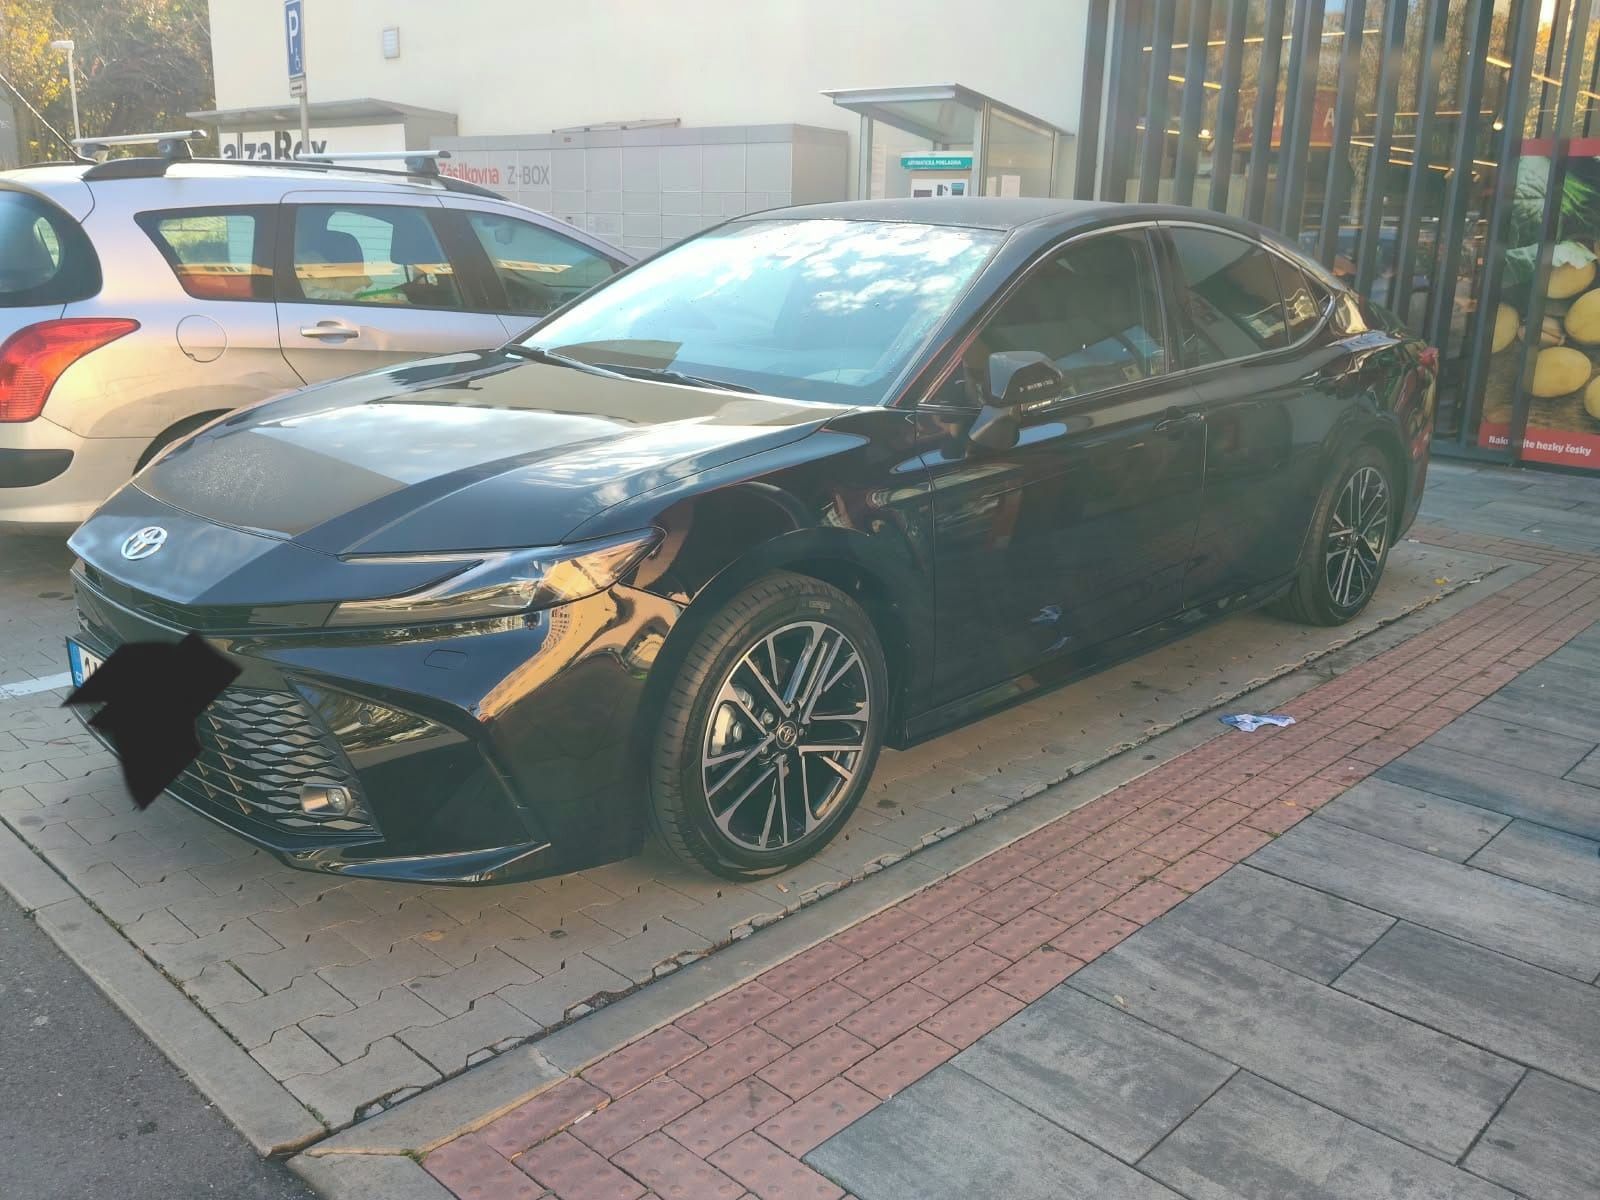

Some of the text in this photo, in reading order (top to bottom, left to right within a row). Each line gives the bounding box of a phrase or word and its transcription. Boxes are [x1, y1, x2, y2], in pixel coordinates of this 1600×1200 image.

[288, 9, 299, 54] P
[507, 165, 550, 185] Z-BOX
[1488, 435, 1592, 457] Nakujte hezky česky
